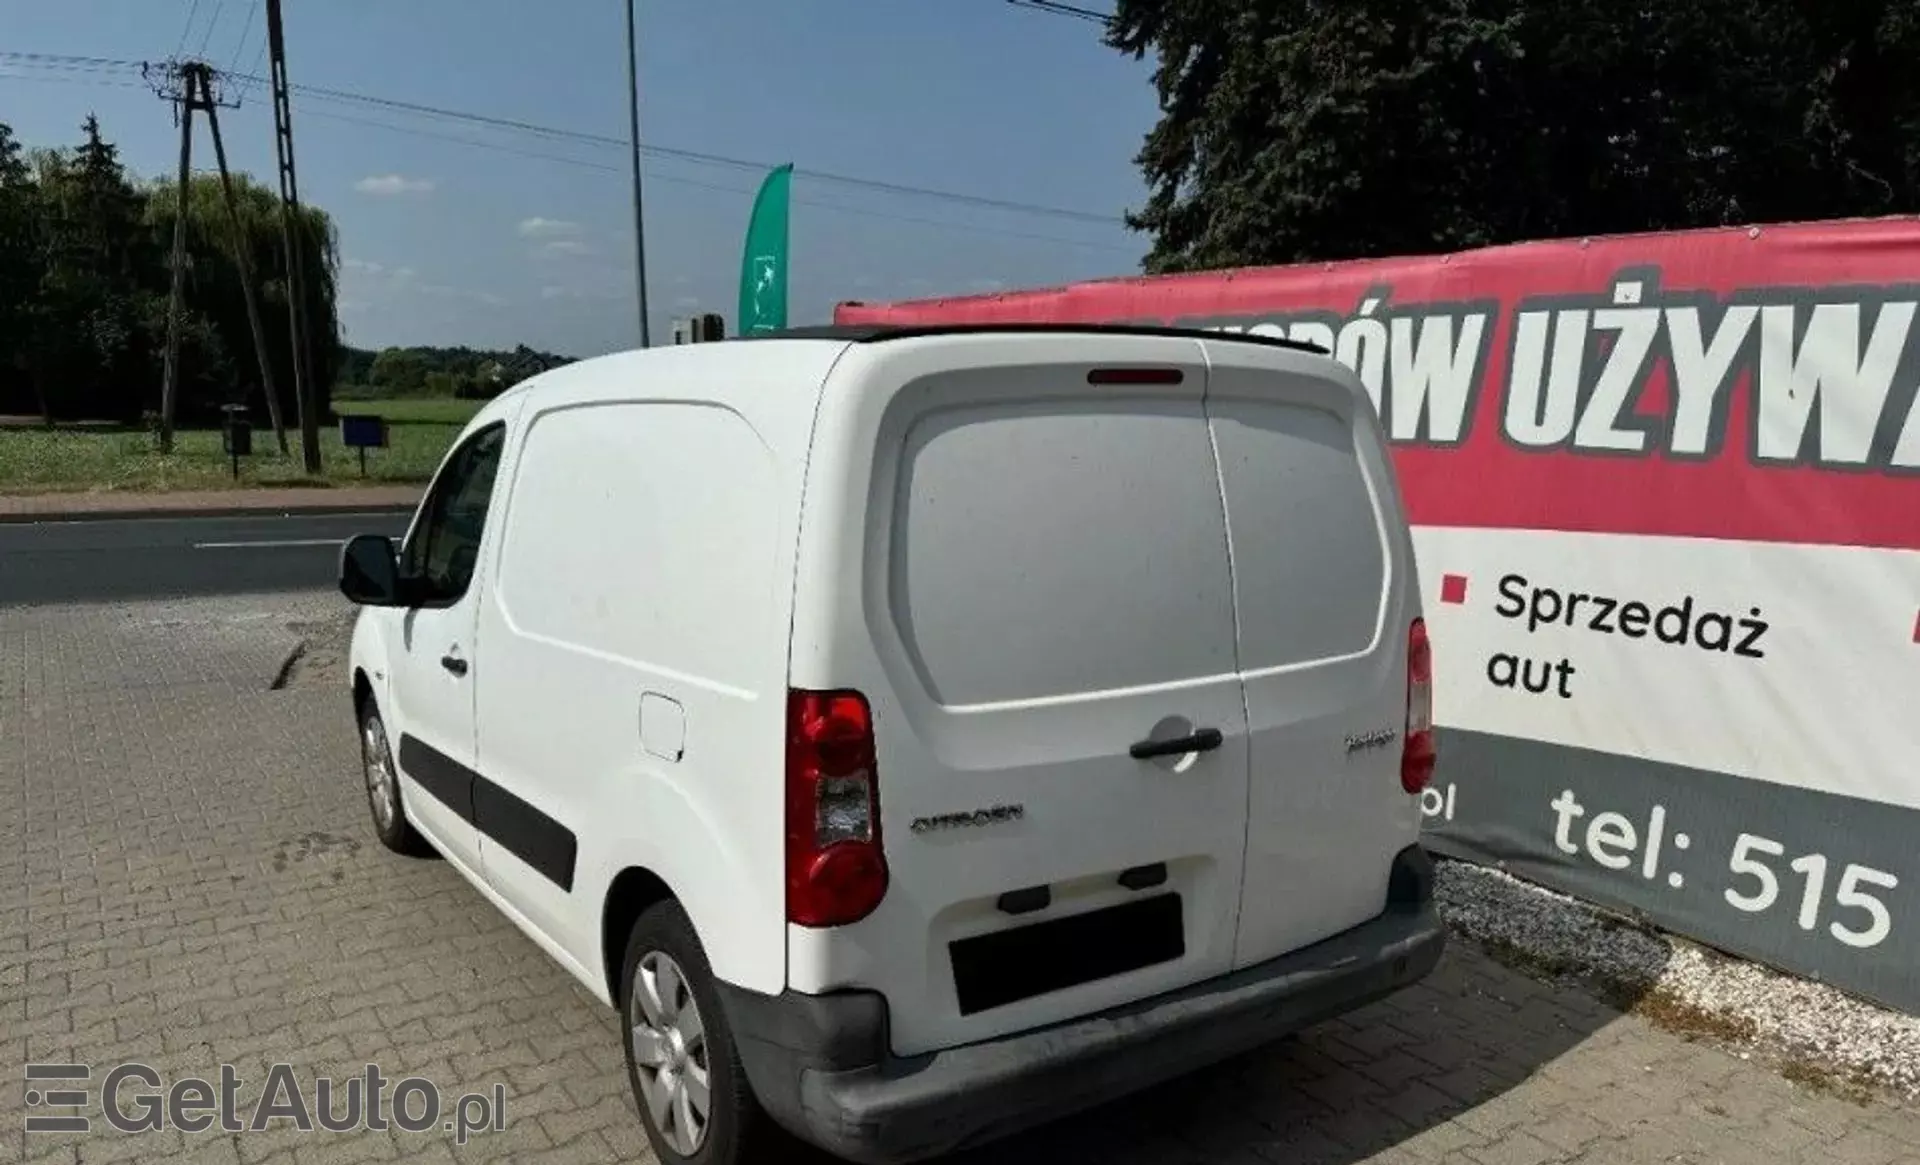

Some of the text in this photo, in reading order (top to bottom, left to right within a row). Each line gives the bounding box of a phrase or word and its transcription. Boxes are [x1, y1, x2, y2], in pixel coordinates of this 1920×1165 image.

[1495, 574, 1769, 658] Sprzedaż
[1487, 653, 1575, 699] aut
[1551, 789, 1690, 888] tel:
[1724, 833, 1898, 947] 515
